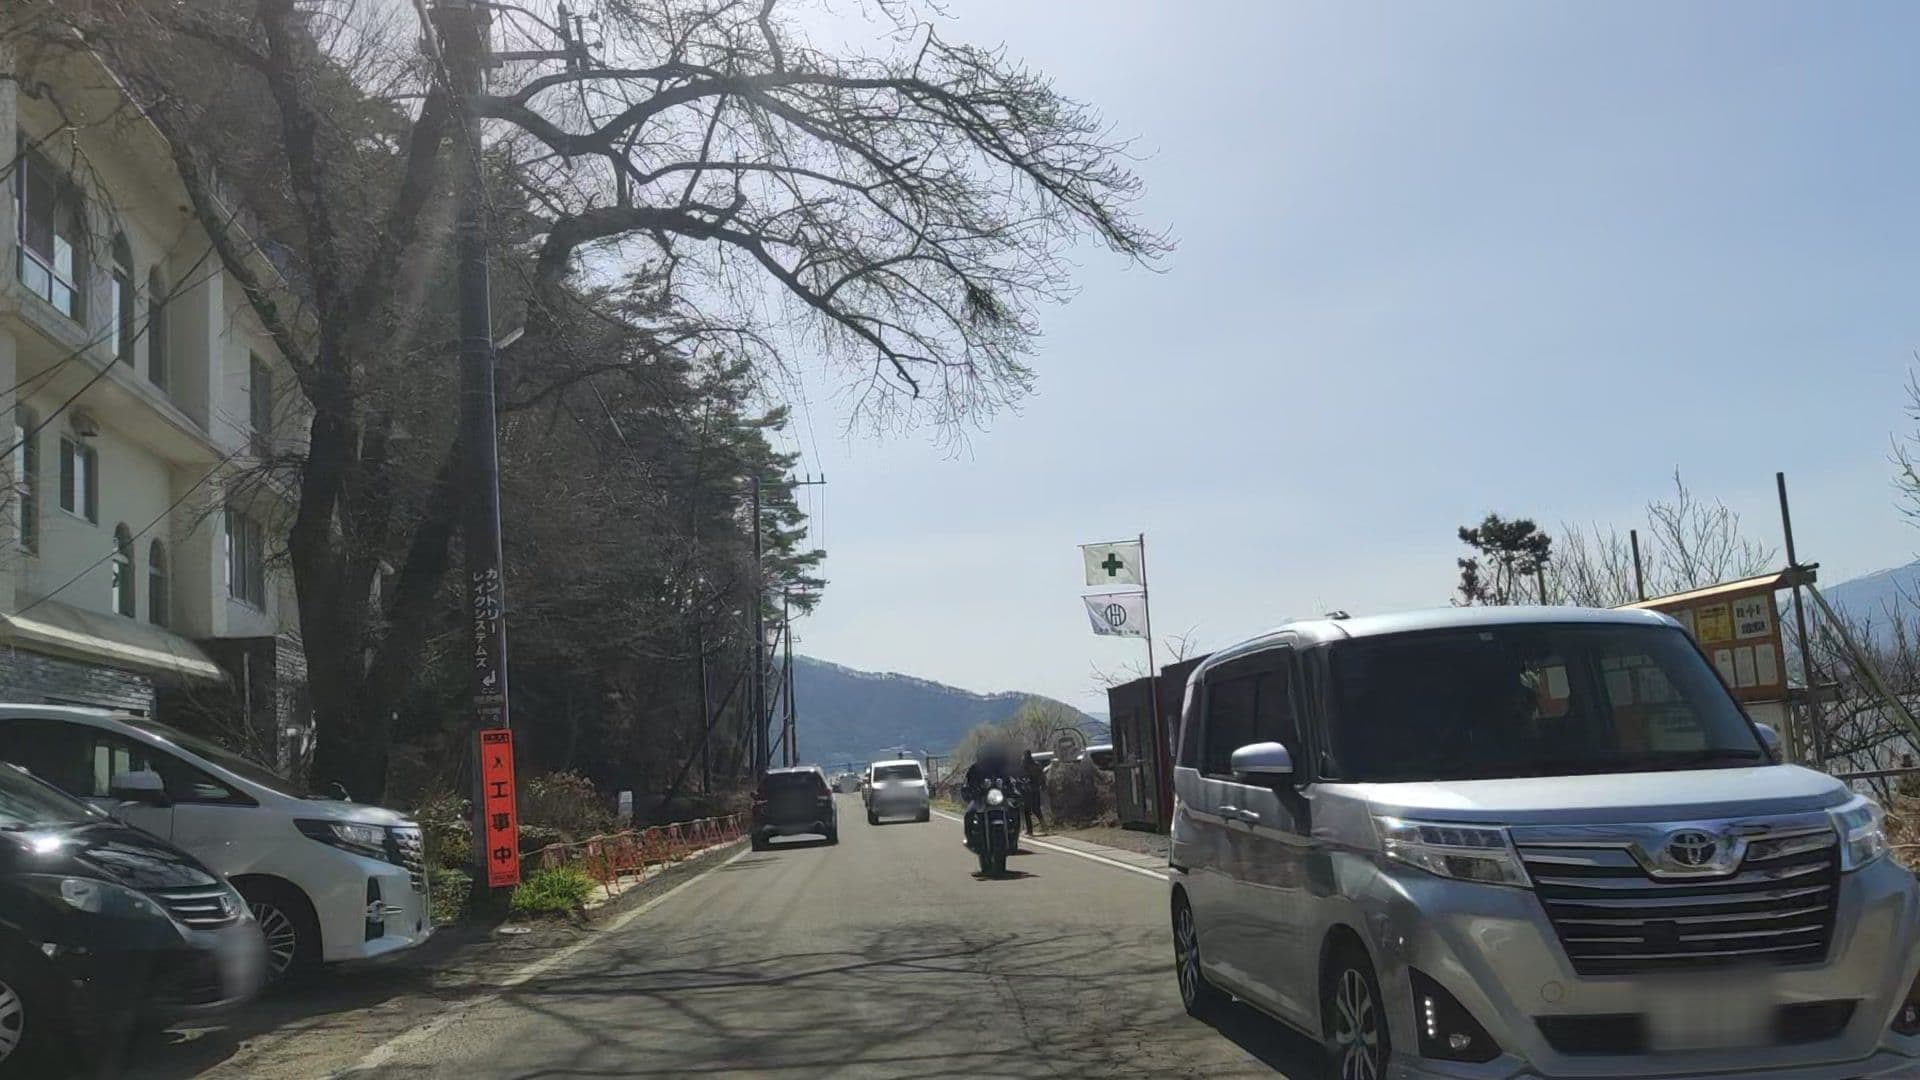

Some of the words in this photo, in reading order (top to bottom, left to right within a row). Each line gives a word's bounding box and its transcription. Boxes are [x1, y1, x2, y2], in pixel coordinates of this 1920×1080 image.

[485, 568, 499, 634] カントリー
[489, 781, 512, 864] 工事中
